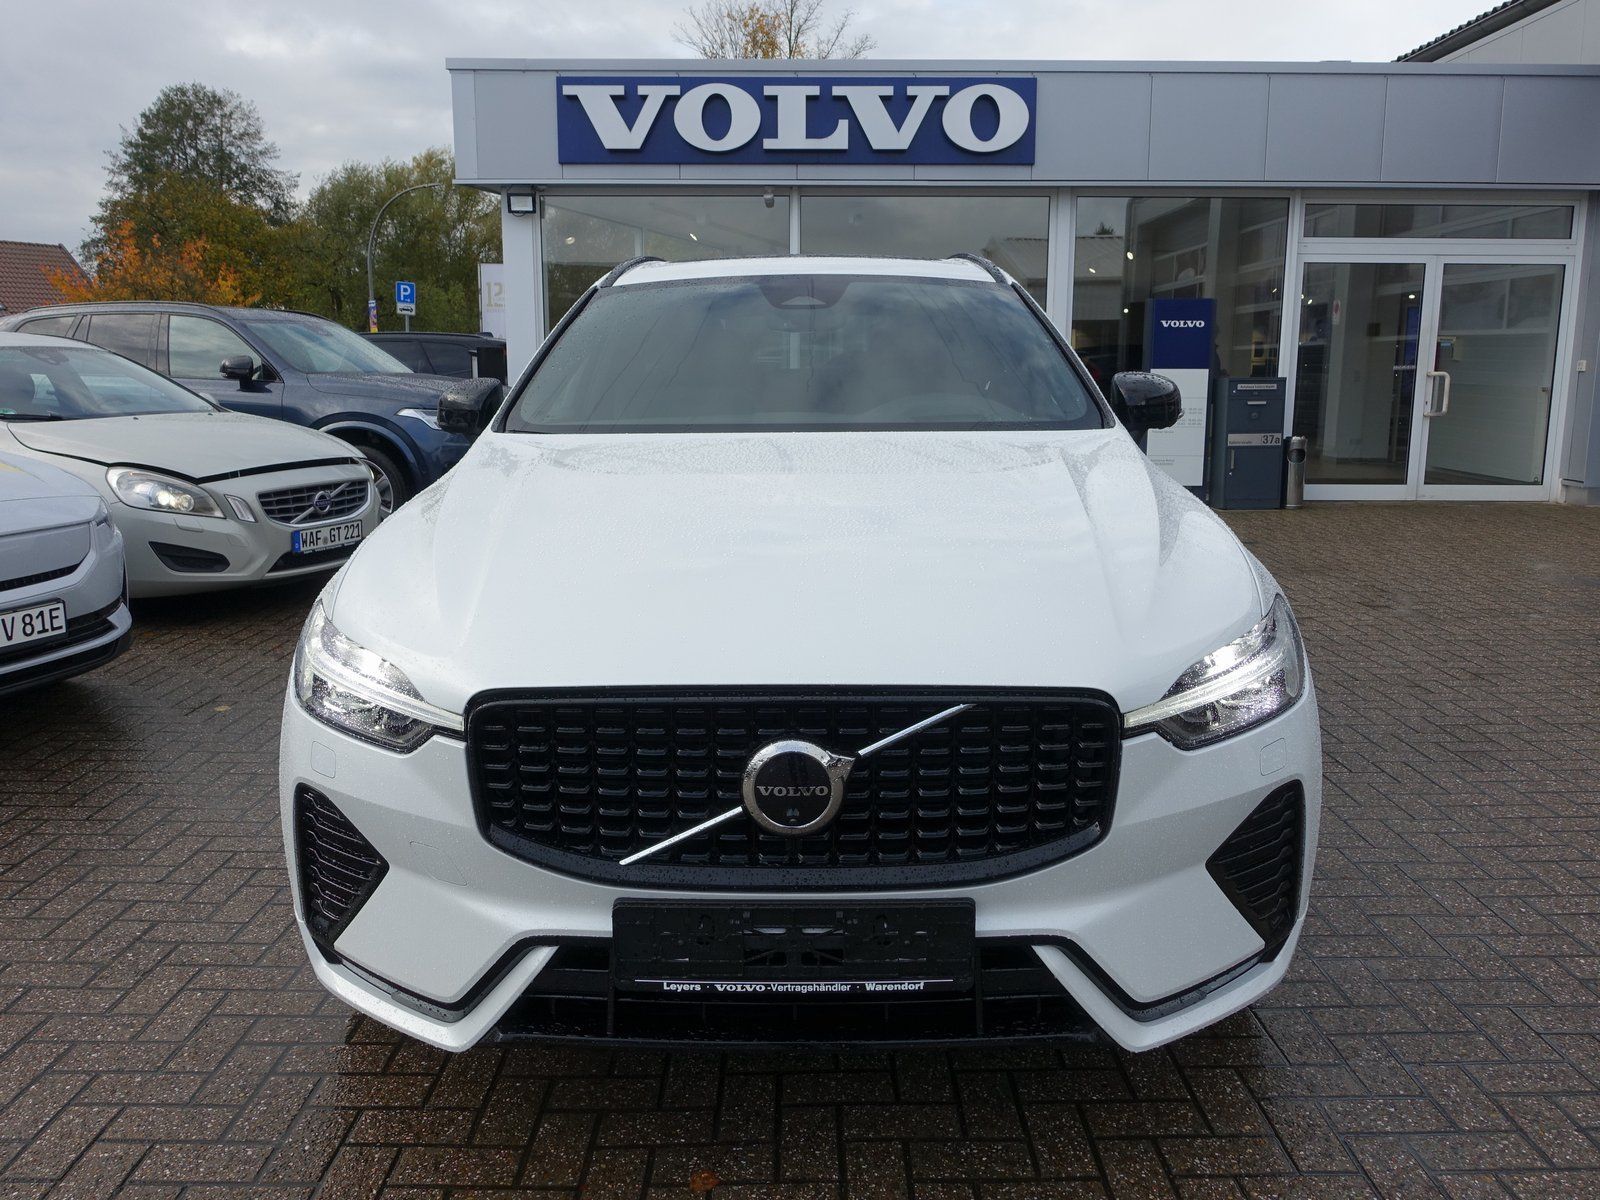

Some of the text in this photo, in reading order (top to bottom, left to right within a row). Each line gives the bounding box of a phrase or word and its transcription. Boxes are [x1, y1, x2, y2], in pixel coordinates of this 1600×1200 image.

[562, 82, 1030, 153] VOLVO
[400, 284, 411, 301] P
[1160, 319, 1205, 328] VOLVO
[1262, 434, 1281, 445] 37a
[301, 523, 360, 547] WAF GT 221
[1, 607, 63, 642] V 81E
[756, 785, 829, 797] VOLVO
[663, 981, 701, 992] Leyers
[865, 981, 925, 992] Warendorf
